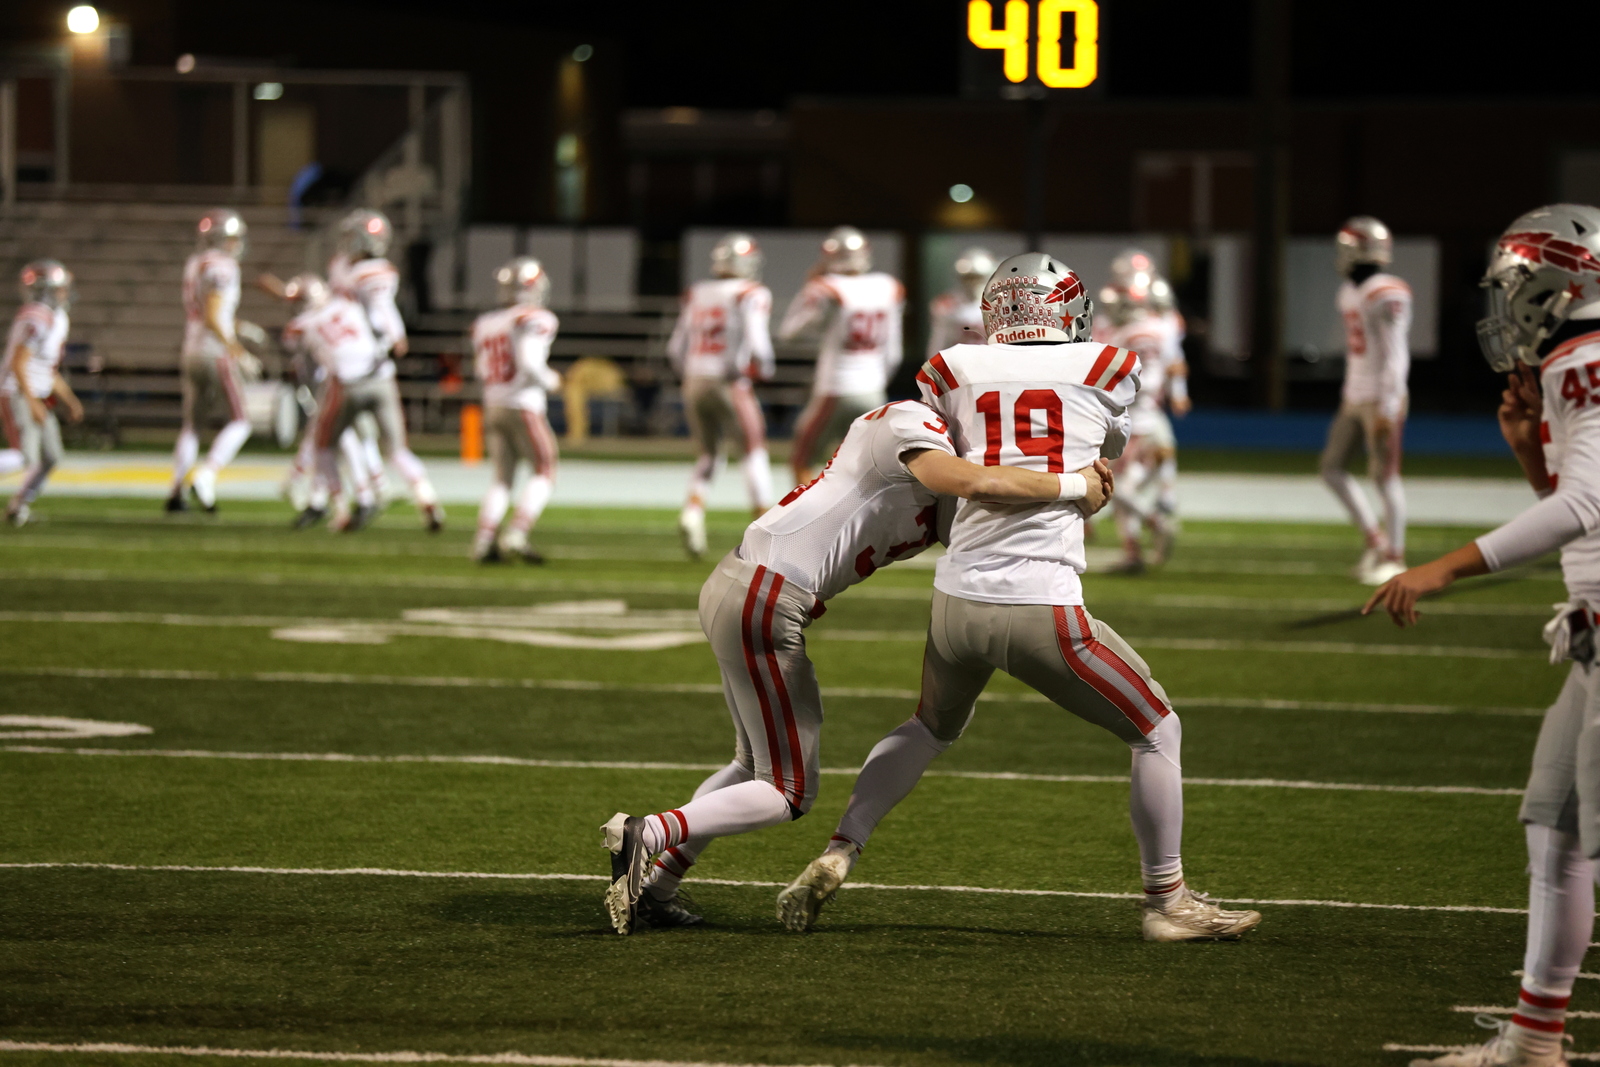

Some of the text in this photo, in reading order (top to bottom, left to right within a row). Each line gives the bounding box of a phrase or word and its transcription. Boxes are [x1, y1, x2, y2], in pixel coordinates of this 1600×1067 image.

[967, 0, 1098, 88] 40
[996, 328, 1046, 343] Riddell
[976, 389, 1065, 473] 19
